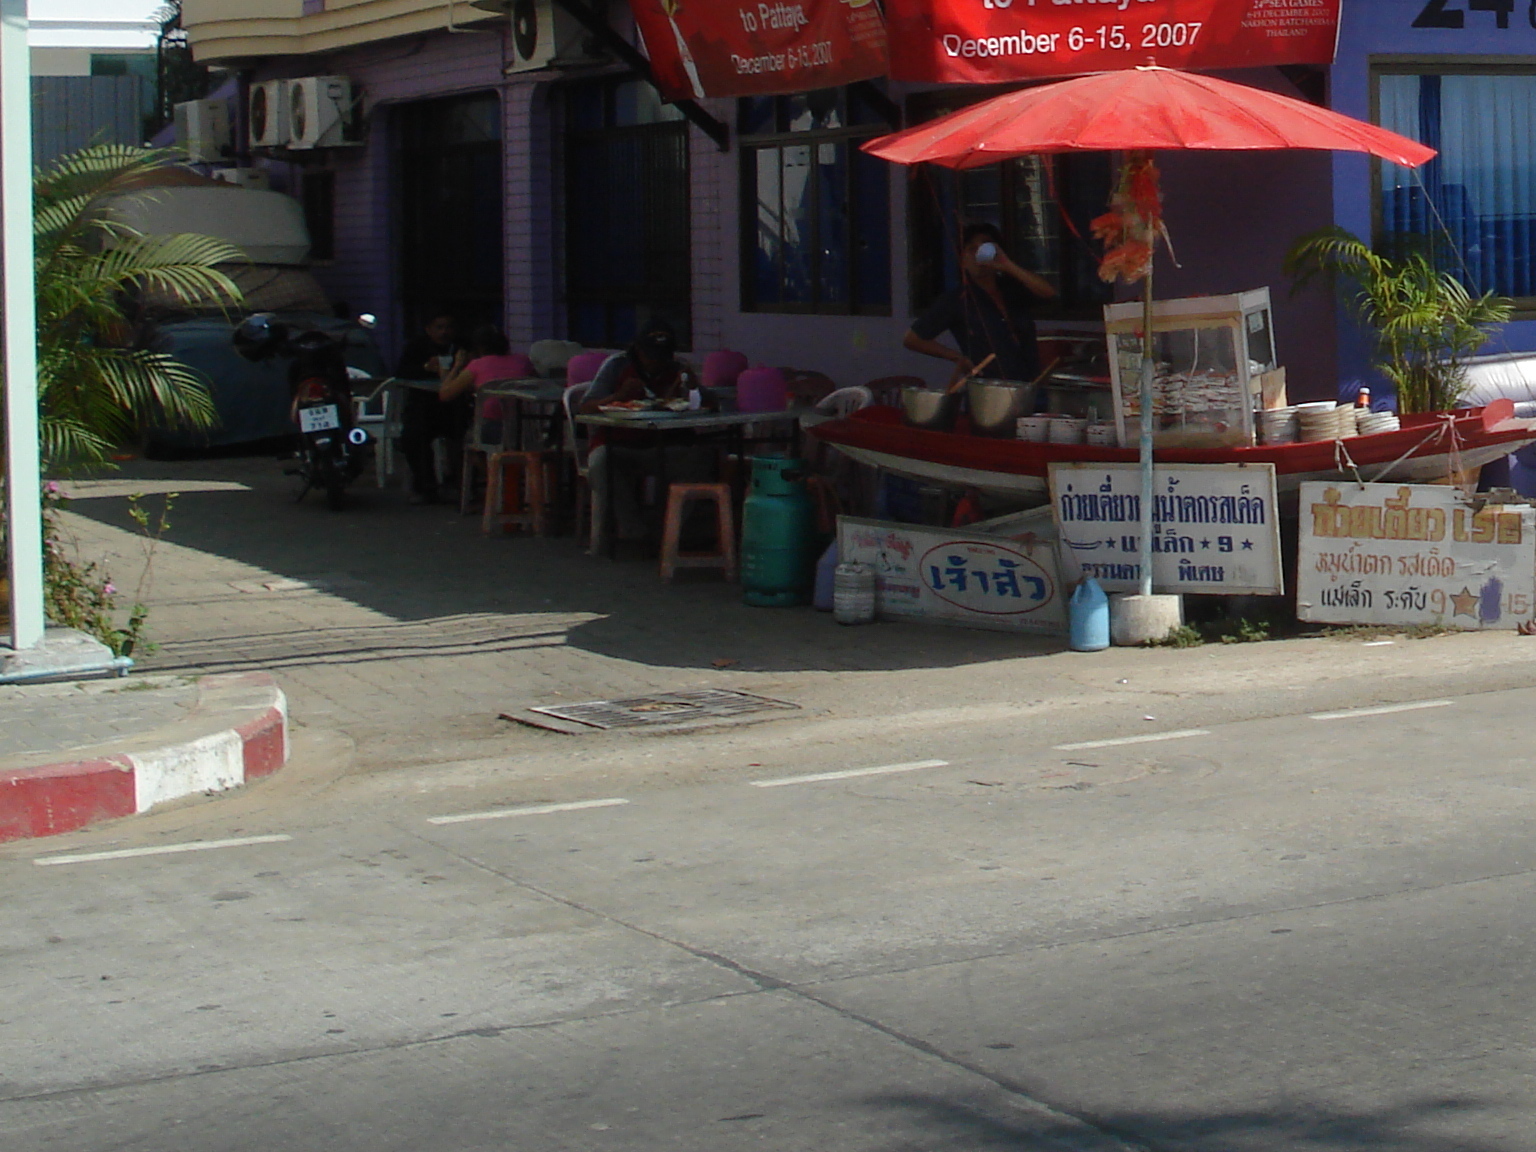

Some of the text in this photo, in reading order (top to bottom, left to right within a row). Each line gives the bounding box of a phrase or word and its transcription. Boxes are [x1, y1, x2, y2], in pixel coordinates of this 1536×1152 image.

[739, 8, 757, 33] to
[943, 22, 1202, 57] December 6-15, 2007
[731, 52, 785, 75] December
[1217, 535, 1234, 553] 9
